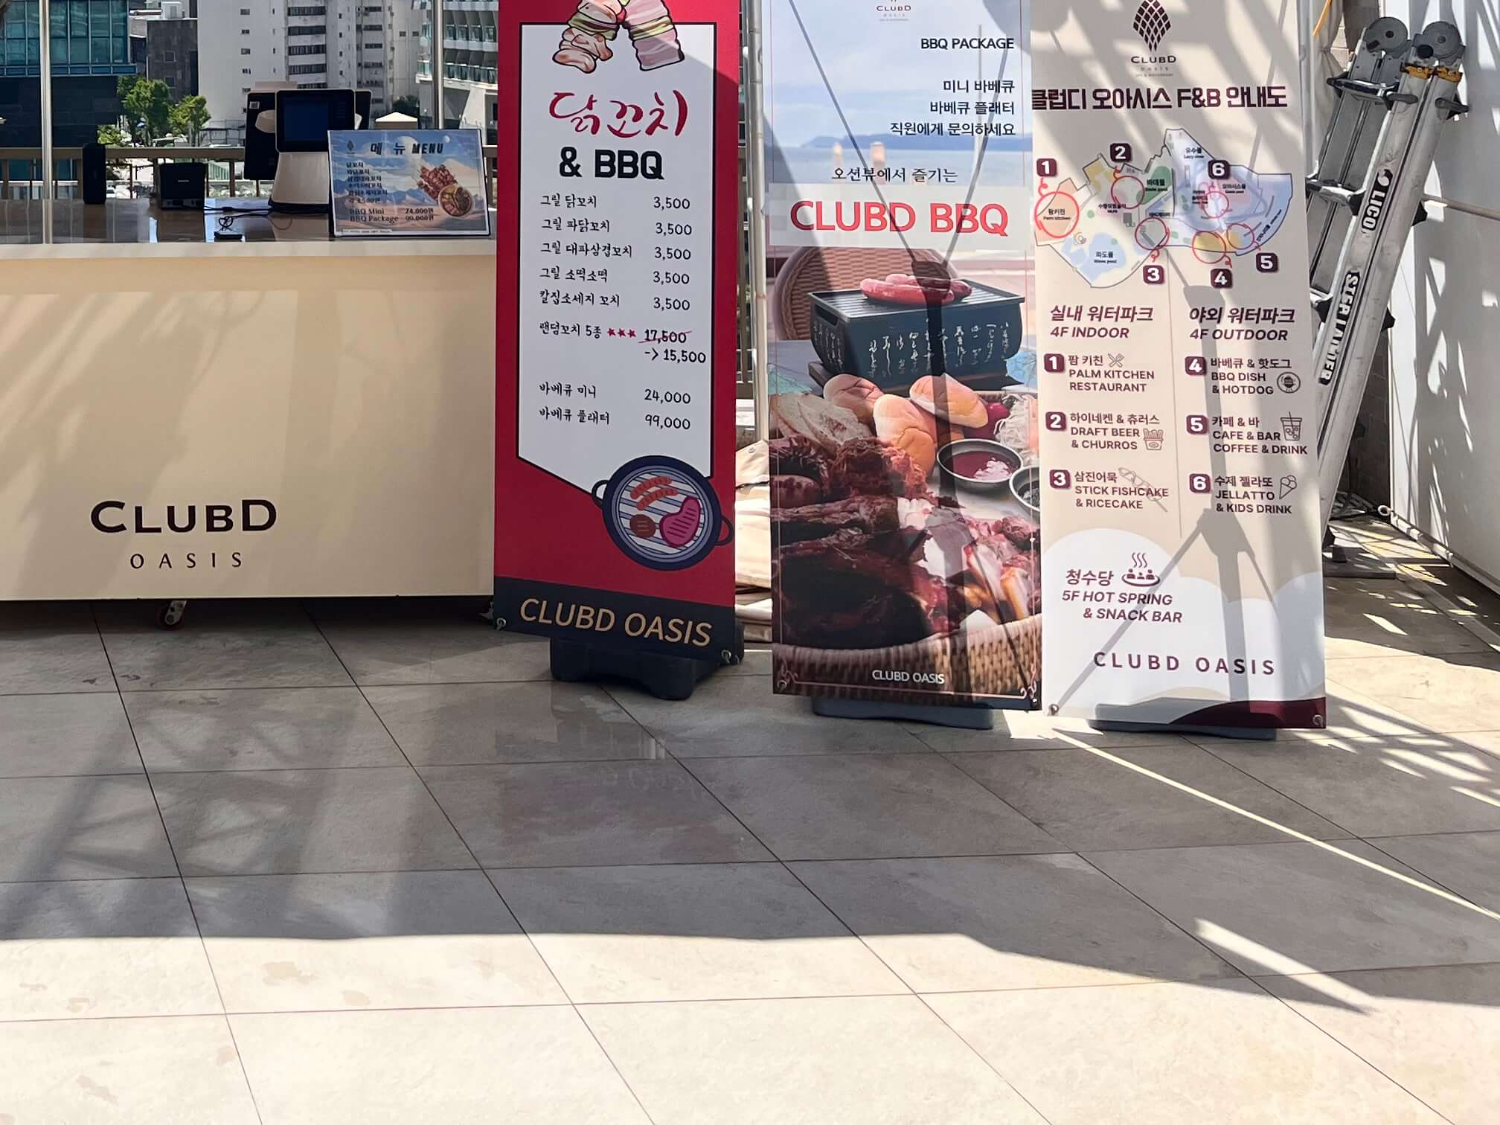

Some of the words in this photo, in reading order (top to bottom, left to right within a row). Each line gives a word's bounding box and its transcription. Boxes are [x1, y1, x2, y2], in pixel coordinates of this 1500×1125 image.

[921, 39, 948, 50] BBQ
[952, 38, 1014, 49] PACKAGE
[1131, 55, 1176, 64] CLUBD
[943, 80, 969, 93] 미니
[974, 80, 1015, 93] 바베큐
[1032, 89, 1086, 110] 클럽디
[1092, 88, 1172, 110] 오아시스
[1177, 88, 1220, 107] F&B
[1226, 86, 1287, 107] 안내도
[549, 90, 688, 138] 닭꼬치
[930, 101, 970, 115] 바베큐
[974, 101, 1014, 115] 플래터
[890, 123, 943, 135] 직원에게
[948, 123, 1016, 136] 문의하세요
[393, 143, 405, 155] 뉴
[412, 143, 443, 154] MENU
[559, 146, 582, 178] &
[595, 149, 665, 180] BBQ
[832, 167, 906, 182] 오션뷰에서
[912, 168, 958, 183] 즐기는
[540, 193, 560, 207] 그릴
[565, 194, 597, 209] 닭꼬치
[653, 196, 690, 210] 3,500
[1363, 191, 1385, 229] LICO
[791, 200, 916, 232] CLUBD
[930, 202, 1008, 236] BBQ
[541, 217, 562, 231] 그릴
[567, 218, 610, 233] 파닭꼬치
[655, 223, 692, 236] 3,500
[540, 241, 561, 254] 그릴
[654, 247, 691, 261] 3,500
[539, 266, 560, 279] 그릴
[565, 267, 608, 283] 소떡소떡
[653, 271, 690, 285] 3,500
[599, 294, 620, 307] 꼬치
[653, 297, 690, 311] 3,500
[1051, 305, 1082, 322] 실내
[1088, 305, 1153, 323] 워터파크
[1190, 307, 1223, 324] 야외
[1228, 307, 1295, 324] 워터파크
[539, 321, 580, 336] 랜덤꼬치
[585, 326, 601, 339] 5종
[644, 329, 687, 344] 17,500
[1051, 327, 1069, 338] 4F
[1072, 327, 1129, 338] INDOOR
[1190, 329, 1209, 340] 4F
[1212, 329, 1288, 341] OUTDOOR
[664, 349, 706, 364] 15,500
[1068, 355, 1079, 366] 팜
[1082, 355, 1103, 366] 키친
[1211, 358, 1242, 369] 바베큐
[1247, 359, 1255, 368] &
[1259, 358, 1292, 369] 핫도그
[1069, 370, 1101, 379] PALM
[1104, 370, 1154, 380] KITCHEN
[1211, 372, 1235, 382] BBQ
[1238, 372, 1266, 382] DISH
[539, 382, 573, 398] 바베큐
[577, 385, 596, 399] 미니
[644, 388, 691, 404] 24,000
[1069, 382, 1147, 392] RESTAURANT
[1222, 385, 1274, 395] HOTDOG
[539, 406, 572, 422] 바베큐
[577, 410, 610, 425] 플래터
[645, 414, 690, 430] 99,000
[1070, 413, 1113, 425] 하이네켄
[1116, 414, 1124, 423] &
[1127, 413, 1160, 425] 츄러스
[1212, 417, 1234, 428] 카페
[1237, 418, 1245, 426] &
[1249, 417, 1260, 428] 바
[1071, 427, 1108, 436] DRAFT
[1111, 428, 1140, 437] BEER
[1213, 431, 1243, 440] CAFE
[1247, 432, 1254, 440] &
[1257, 432, 1281, 441] BAR
[1082, 440, 1137, 450] CHURROS
[1213, 444, 1258, 454] COFFEE
[1262, 445, 1269, 454] &
[1272, 445, 1307, 455] DRINK
[1075, 471, 1117, 483] 삼진어묵
[1214, 476, 1237, 487] 수제
[1240, 476, 1273, 487] 젤라또
[1075, 486, 1109, 495] STICK
[1112, 487, 1168, 497] FISHCAKE
[1215, 490, 1275, 500] JELLATTO
[1086, 499, 1143, 509] RICECAKE
[1226, 503, 1253, 513] KIDS
[1256, 504, 1292, 514] DRINK
[91, 499, 276, 533] CLUBD
[130, 552, 242, 569] OASIS
[1066, 569, 1114, 586] 청수당
[1062, 590, 1080, 601] 5F
[1083, 591, 1115, 603] HOT
[1118, 593, 1172, 606] SPRING
[520, 598, 615, 632] CLUBD
[624, 612, 712, 647] OASIS
[1096, 608, 1148, 621] SNACK
[1152, 611, 1182, 623] BAR
[1094, 651, 1179, 671] CLUBD
[1196, 657, 1274, 675] OASIS
[872, 670, 910, 681] CLUBD
[913, 673, 945, 684] OASIS
